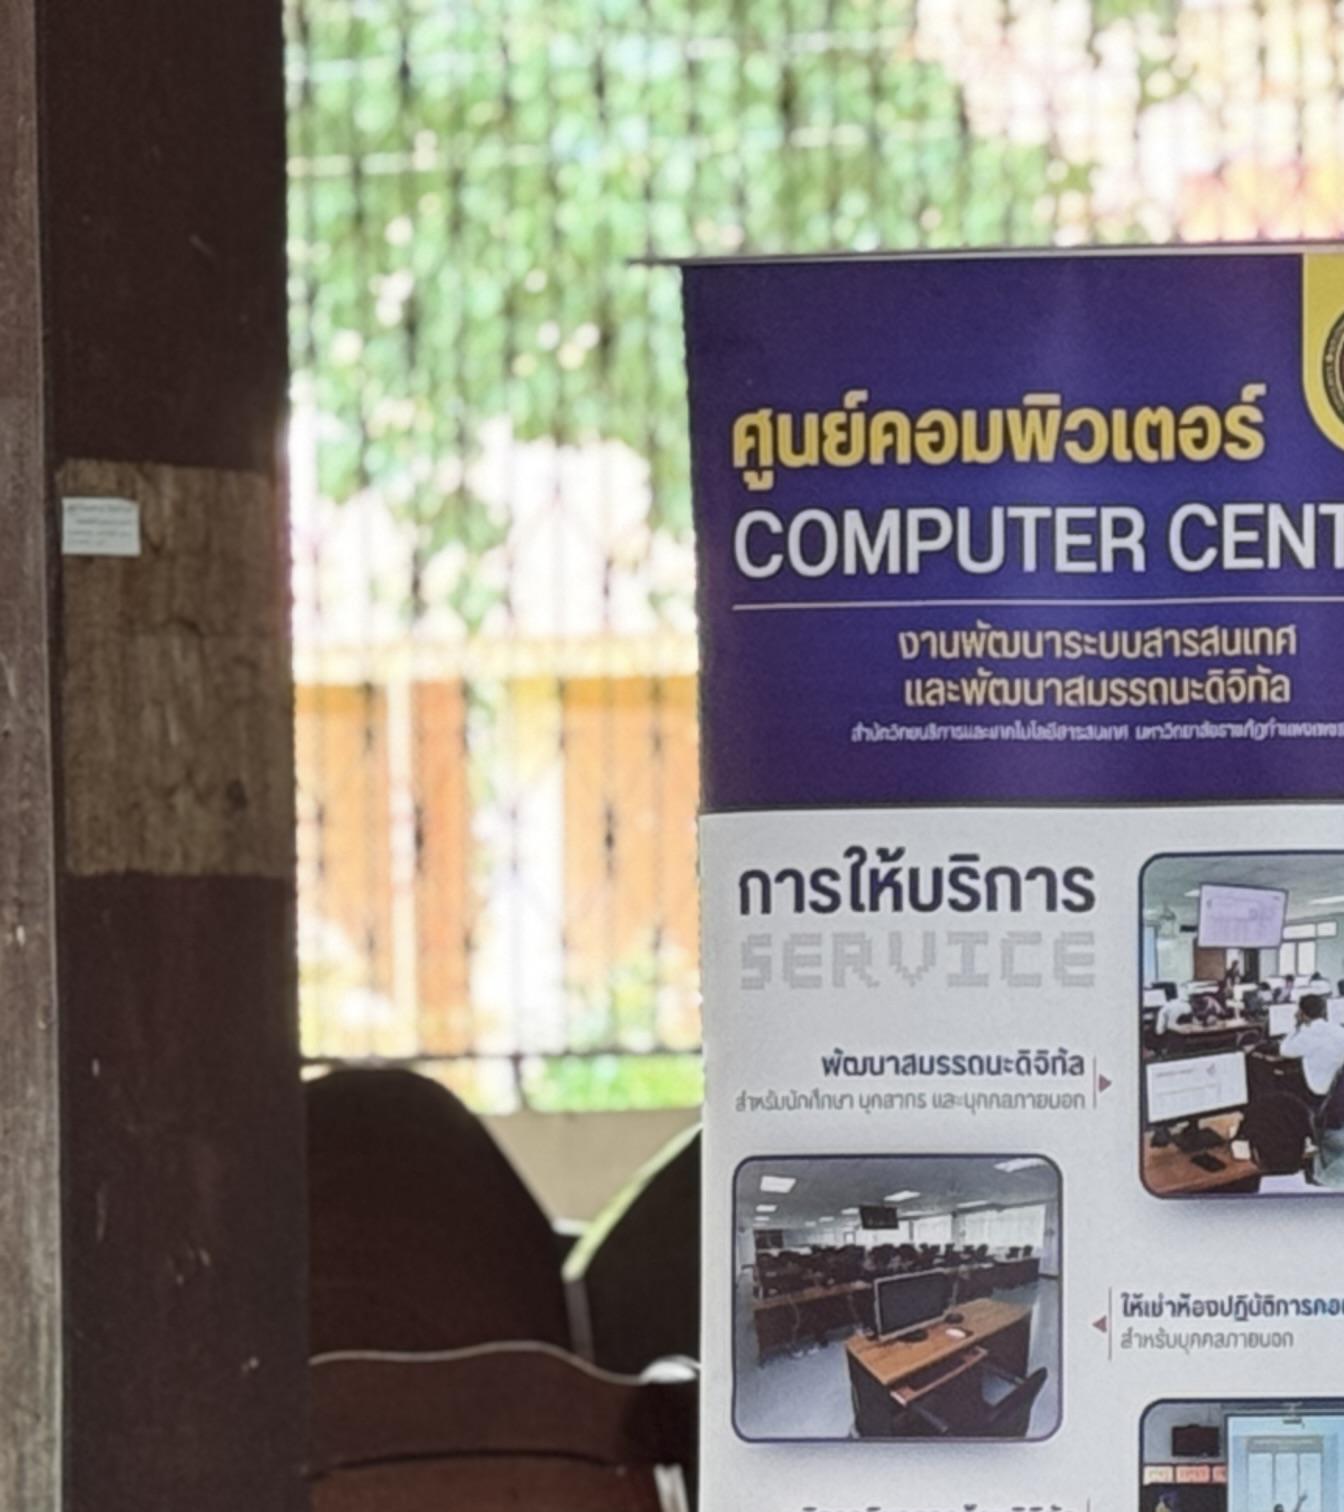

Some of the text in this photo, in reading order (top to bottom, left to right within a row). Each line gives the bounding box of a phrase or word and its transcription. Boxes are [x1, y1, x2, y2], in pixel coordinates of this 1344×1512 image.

[731, 384, 1267, 491] ศูนย์คอมพิวเตอร์
[733, 505, 1147, 579] COMPUTER
[898, 619, 1298, 661] งานพัฒนาระบบสารสนเทศ
[904, 665, 1292, 708] และพัฒนาสมรรถนะดิจิทัล
[738, 845, 1096, 916] การให้บริการ
[740, 930, 1096, 991] SERVICE
[821, 1048, 1085, 1077] พัฒนาสมรรถนะดิจิทัล
